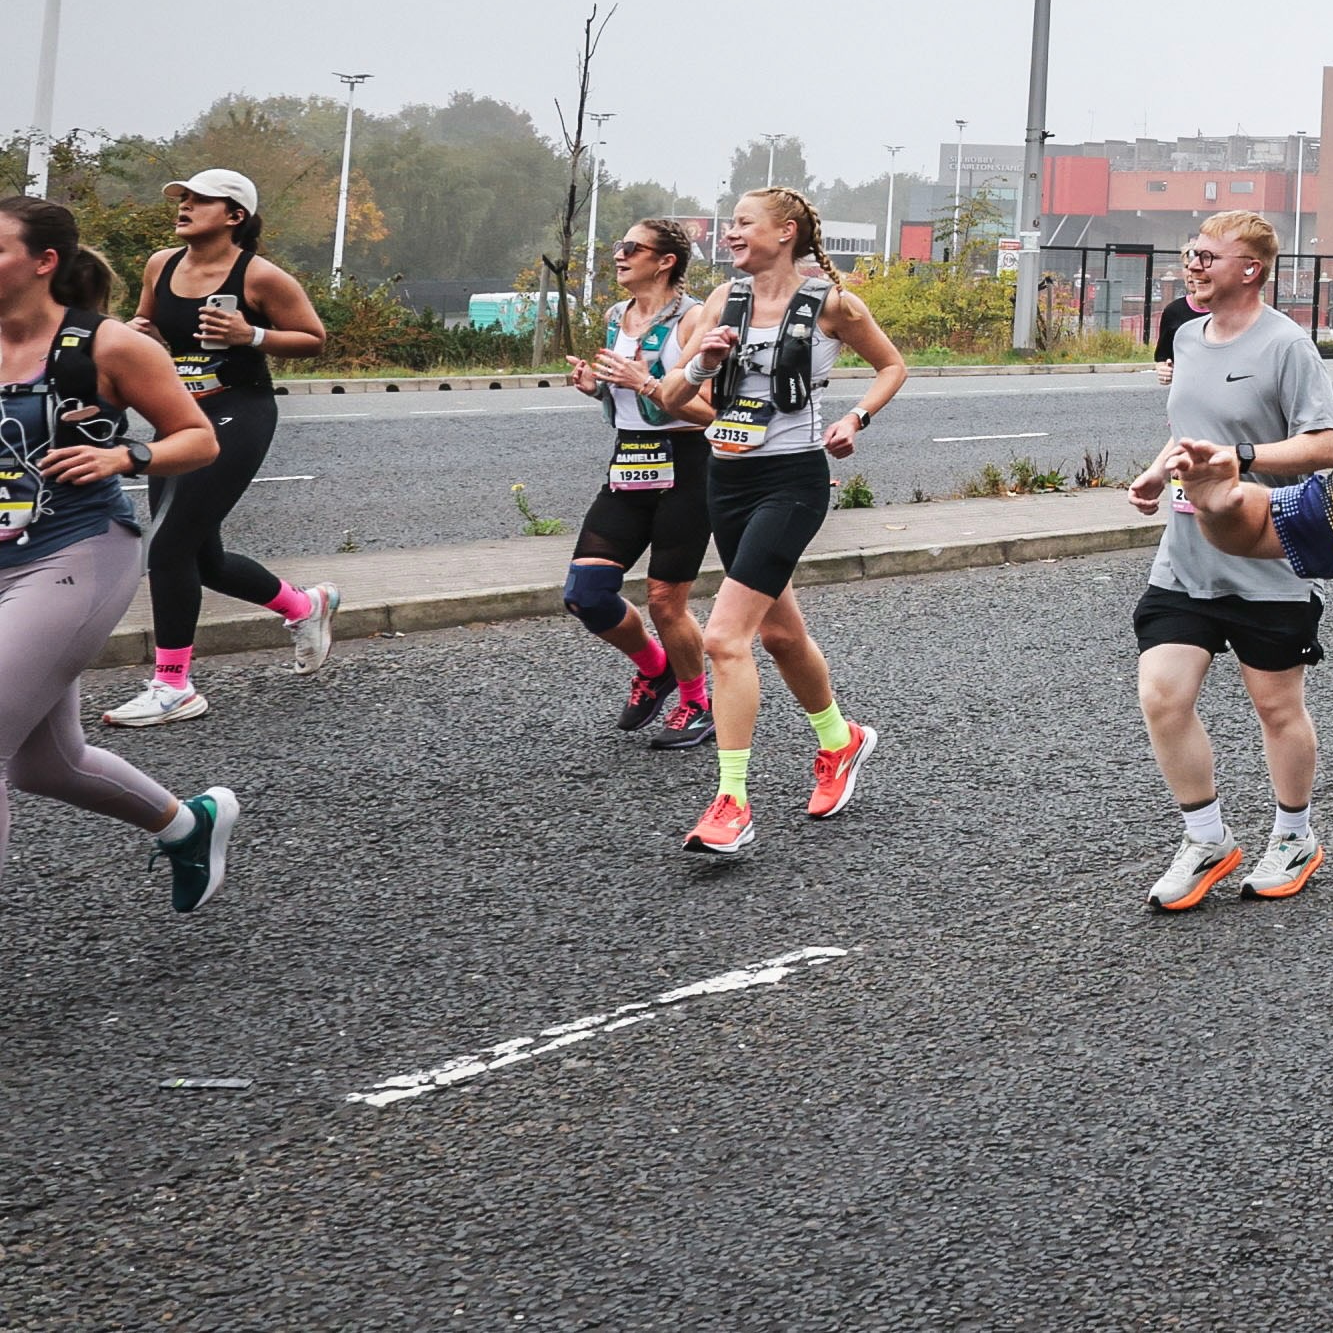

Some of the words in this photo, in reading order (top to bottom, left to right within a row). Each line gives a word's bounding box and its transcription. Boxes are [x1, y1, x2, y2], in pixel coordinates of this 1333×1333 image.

[739, 399, 764, 409] HALF
[713, 428, 748, 443] 23135
[640, 442, 661, 450] HALF
[619, 470, 659, 481] 19269
[156, 664, 184, 674] SRC
